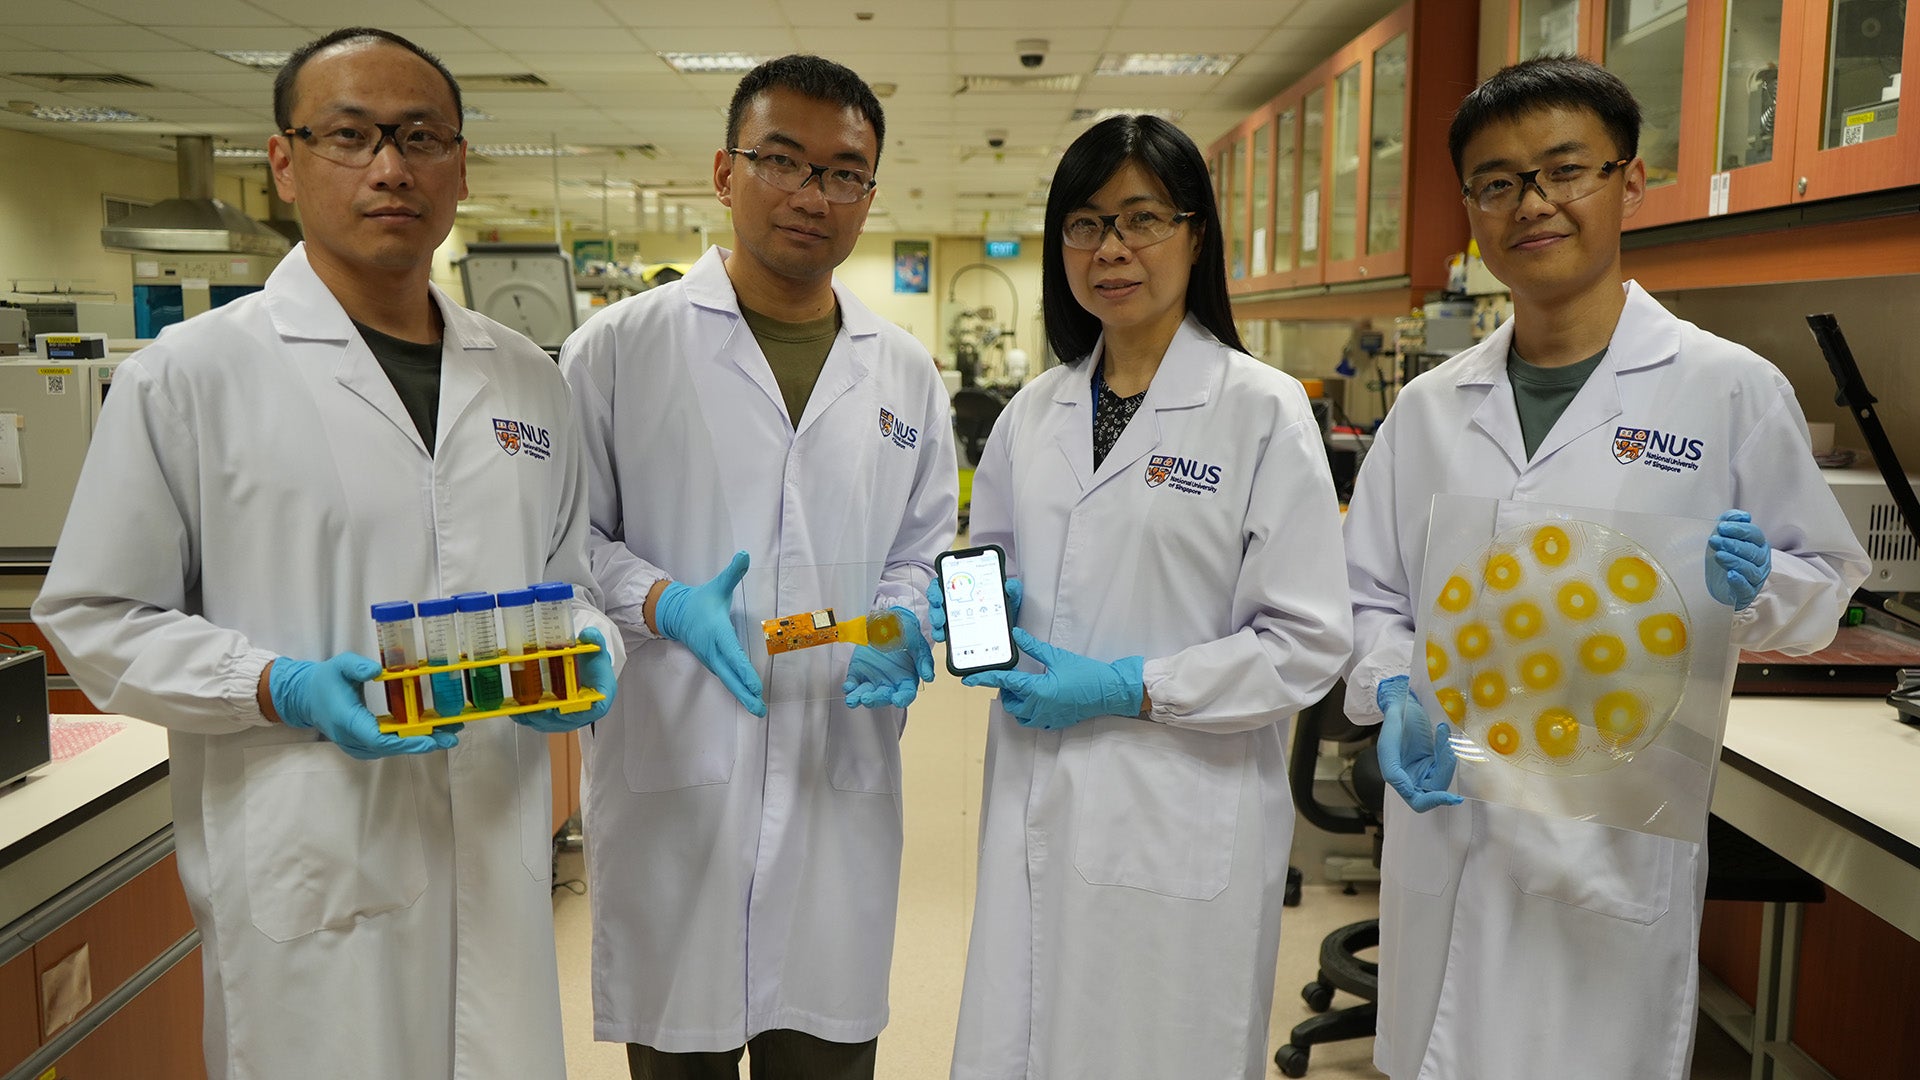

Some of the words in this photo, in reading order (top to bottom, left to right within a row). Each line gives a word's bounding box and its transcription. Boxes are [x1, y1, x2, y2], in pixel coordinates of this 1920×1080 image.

[519, 422, 550, 449] NUS
[894, 418, 918, 443] NUS
[1649, 430, 1704, 461] NUS
[1173, 457, 1222, 485] NUS
[1645, 452, 1671, 464] National
[1670, 459, 1699, 471] University
[1652, 461, 1681, 473] Singapore
[1170, 476, 1192, 486] National
[1191, 481, 1217, 493] University
[1175, 484, 1201, 495] Singapore
